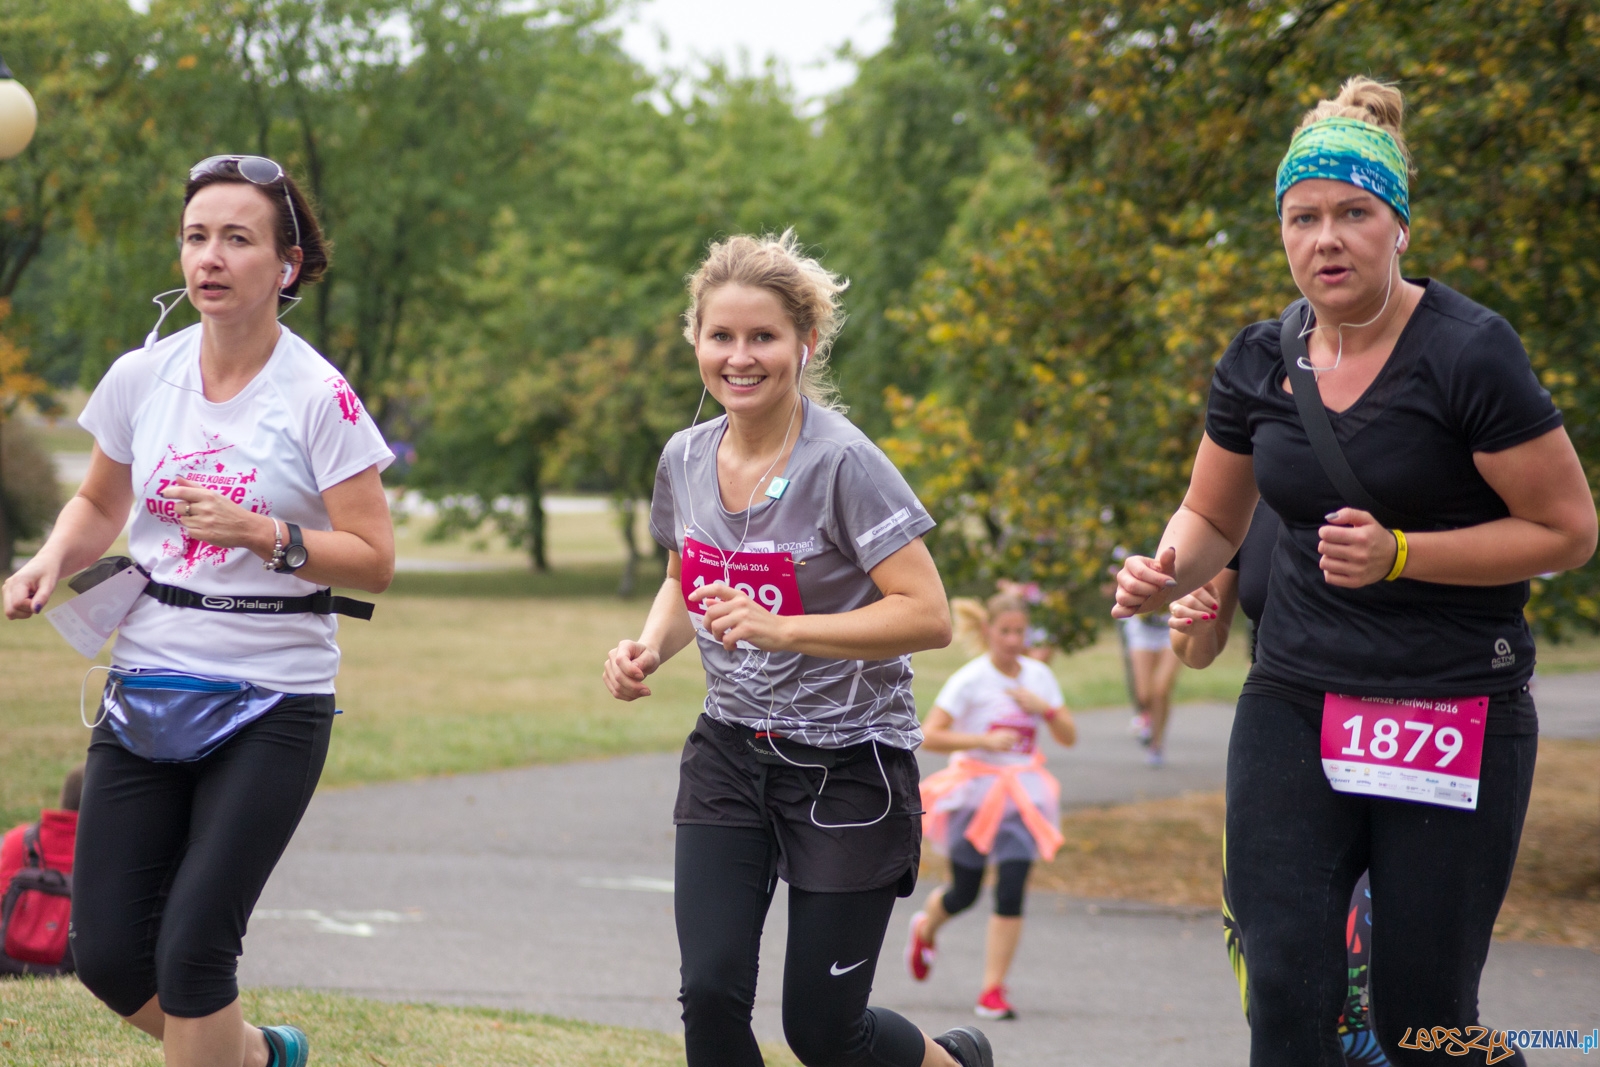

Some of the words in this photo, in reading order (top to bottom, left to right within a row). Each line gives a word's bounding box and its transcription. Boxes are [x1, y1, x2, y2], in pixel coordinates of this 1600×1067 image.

[186, 472, 207, 483] BIEG
[207, 475, 237, 485] KOBIET
[699, 554, 720, 567] Zawsze
[749, 563, 770, 572] 2016
[236, 599, 284, 612] Kalenji
[1434, 702, 1459, 714] 2016
[1341, 714, 1464, 769] 1879
